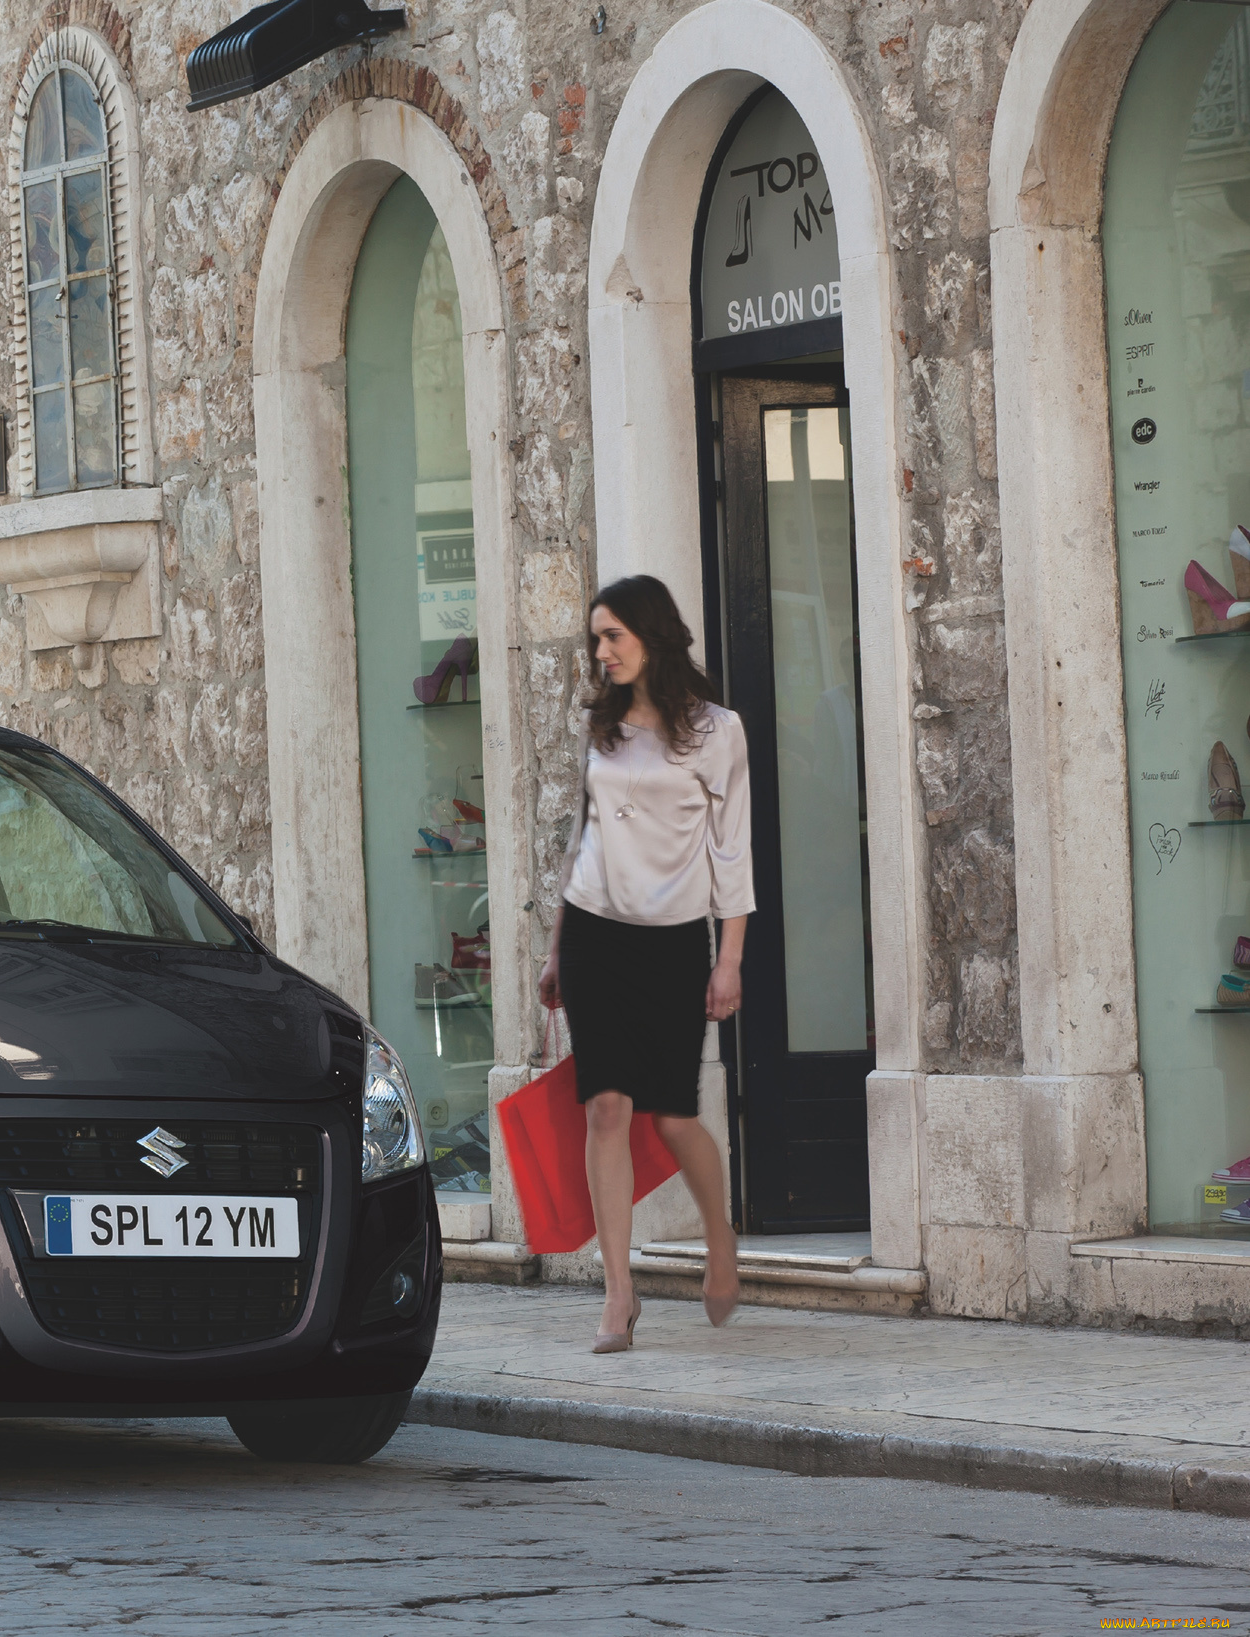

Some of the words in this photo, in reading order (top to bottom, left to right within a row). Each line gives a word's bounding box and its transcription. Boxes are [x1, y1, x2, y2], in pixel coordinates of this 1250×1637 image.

[730, 152, 818, 197] TOP
[727, 288, 804, 333] SALON
[1126, 343, 1154, 360] ESPRIT
[1135, 423, 1153, 438] edc
[1134, 480, 1160, 494] Wrangler
[1132, 529, 1151, 537] MARCO
[90, 1204, 163, 1246] SPL
[175, 1206, 213, 1246] 12
[223, 1206, 276, 1247] YM
